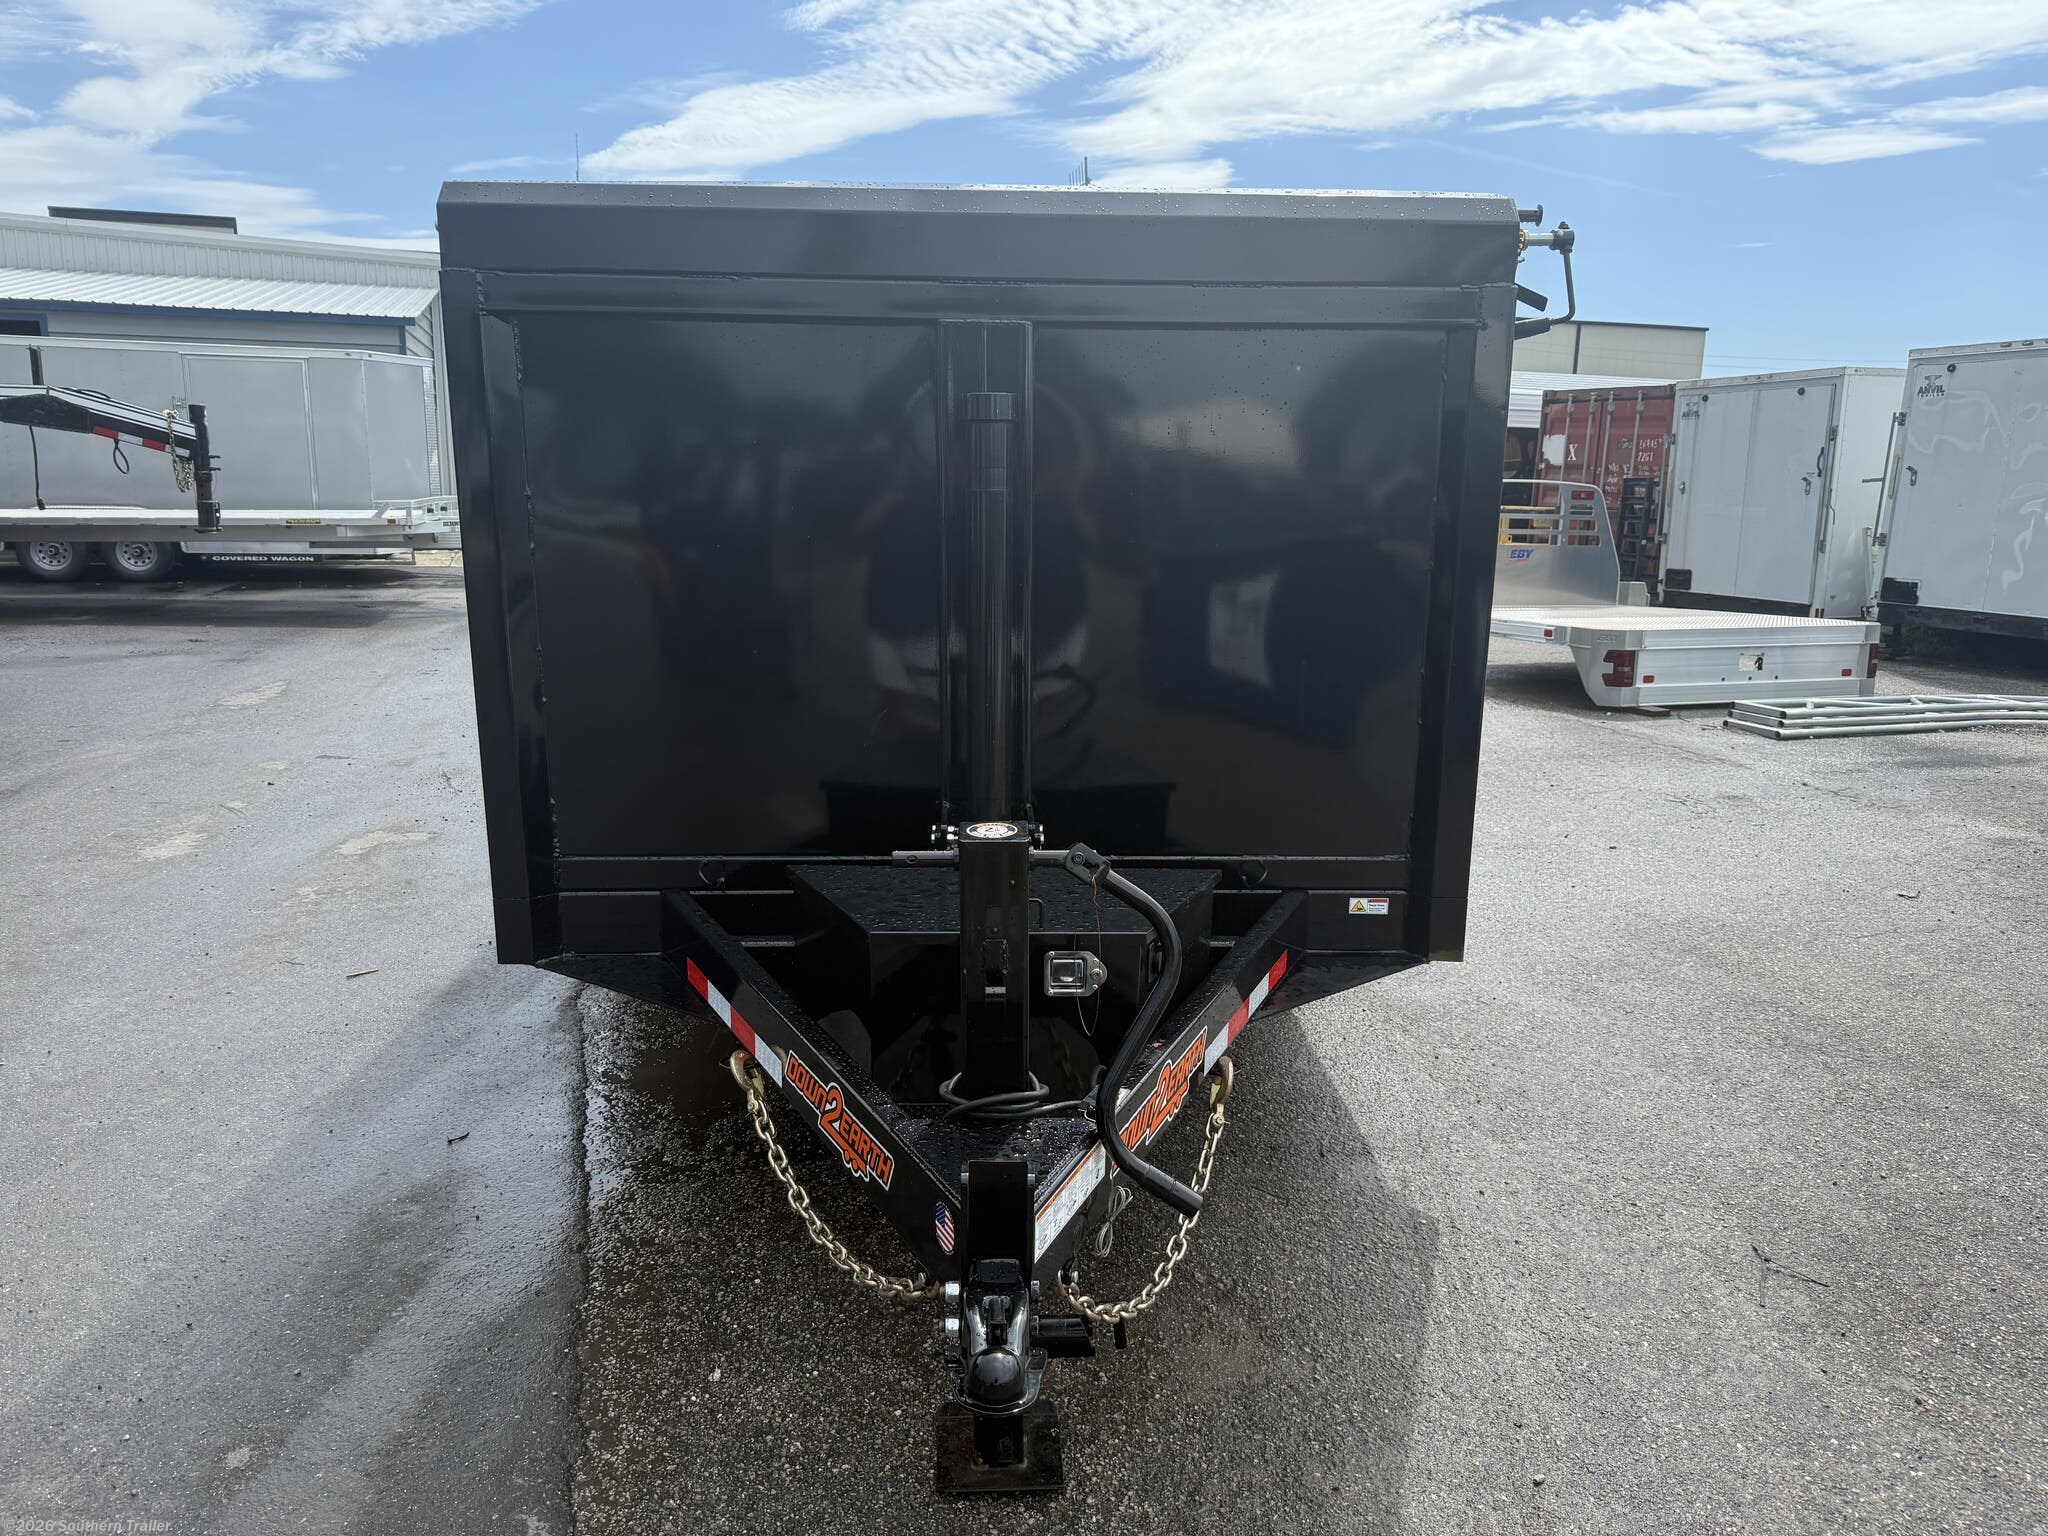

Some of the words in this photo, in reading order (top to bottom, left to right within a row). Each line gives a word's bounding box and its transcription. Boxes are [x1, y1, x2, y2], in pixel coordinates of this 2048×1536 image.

[1917, 385, 1945, 396] ANVIL
[1567, 444, 1578, 461] X
[1510, 549, 1534, 559] EBY
